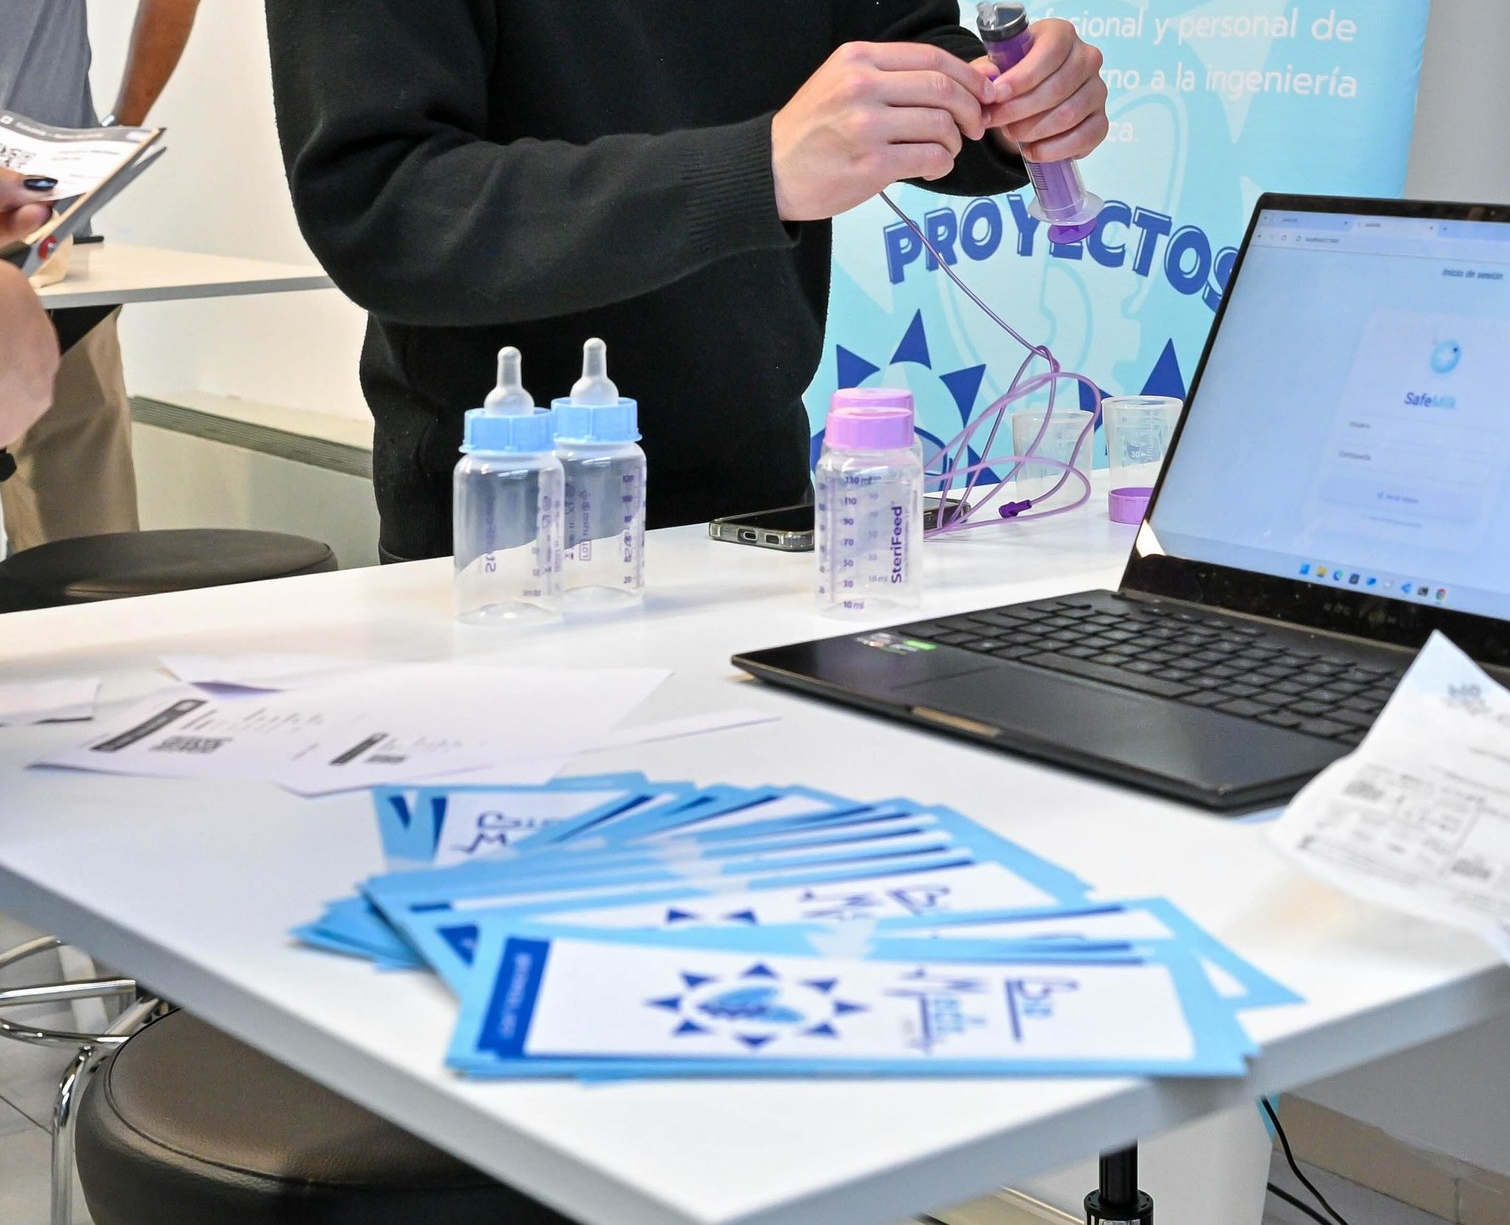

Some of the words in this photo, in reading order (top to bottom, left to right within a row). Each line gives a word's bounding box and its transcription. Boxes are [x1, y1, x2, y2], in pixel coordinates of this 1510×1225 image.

[1153, 17, 1170, 45] y
[1177, 7, 1299, 45] personal
[1311, 8, 1357, 42] de
[1151, 70, 1166, 91] a
[1176, 61, 1196, 92] la
[1205, 64, 1358, 99] ingeniería
[883, 193, 1240, 315] PROYCTO
[844, 538, 854, 546] 70
[890, 506, 902, 584] SteriFeed
